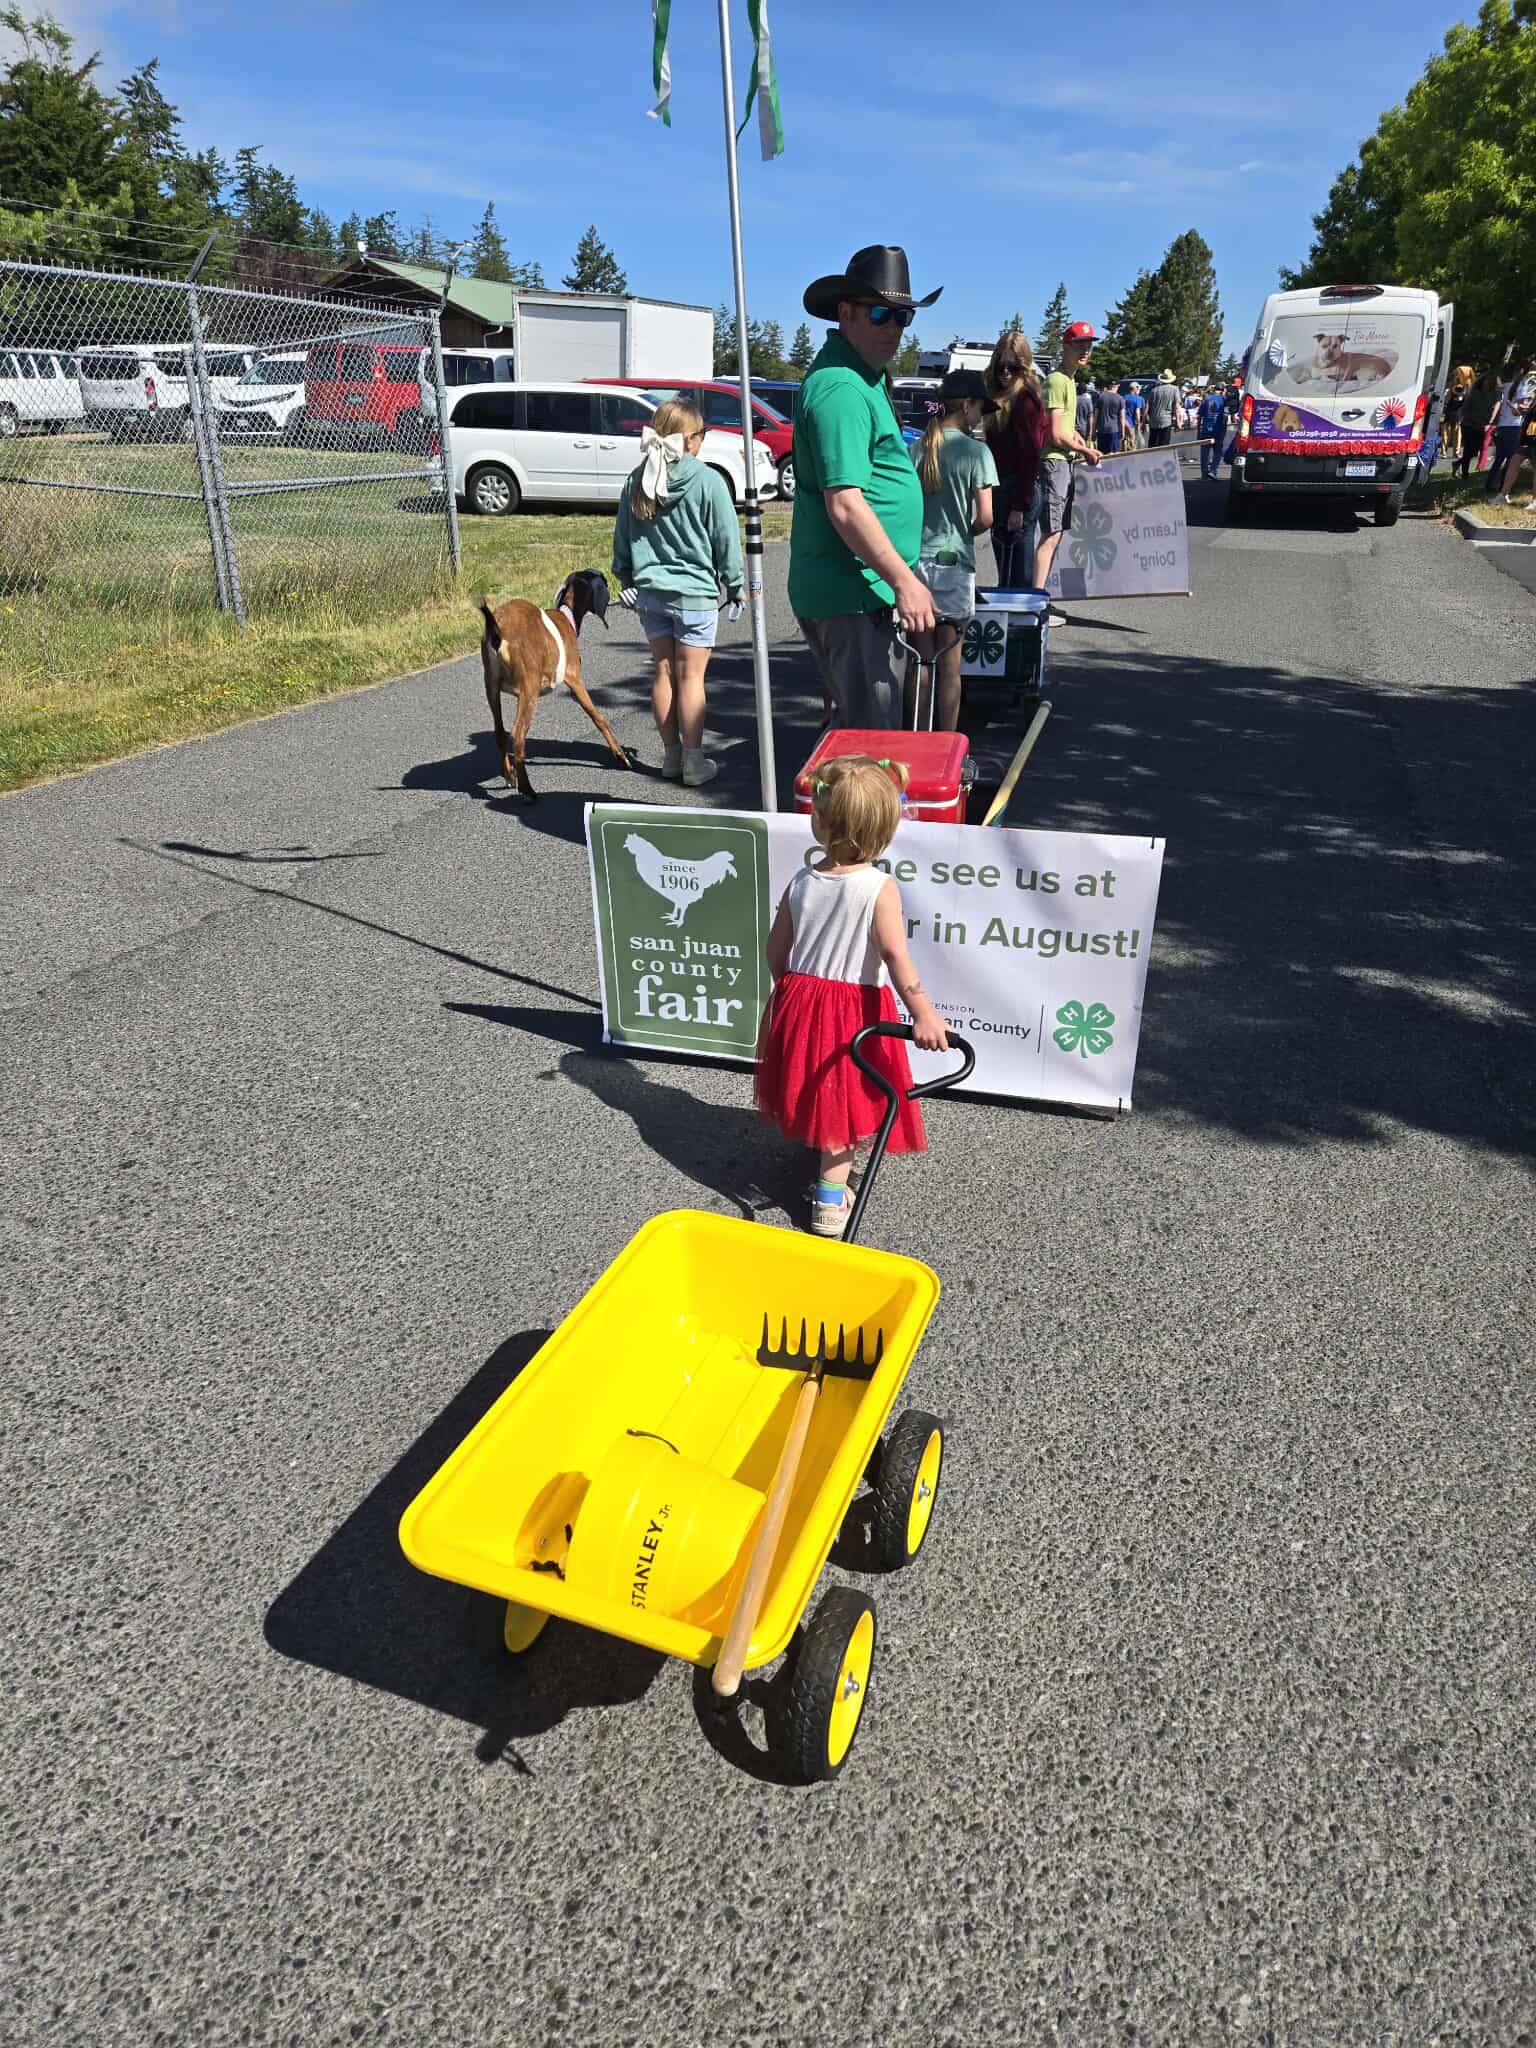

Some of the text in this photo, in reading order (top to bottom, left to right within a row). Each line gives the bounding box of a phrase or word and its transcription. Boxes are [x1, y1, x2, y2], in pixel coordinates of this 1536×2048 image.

[662, 862, 697, 873] since
[930, 861, 1001, 888] see
[1015, 866, 1061, 894] us
[1074, 870, 1117, 899] at
[659, 874, 700, 891] 1906
[629, 935, 742, 959] san juan
[932, 912, 967, 945] in
[979, 917, 1141, 959] August!
[631, 958, 742, 986] county
[633, 974, 743, 1027] fair
[968, 1017, 1032, 1040] County
[631, 1519, 664, 1610] STANLEY
